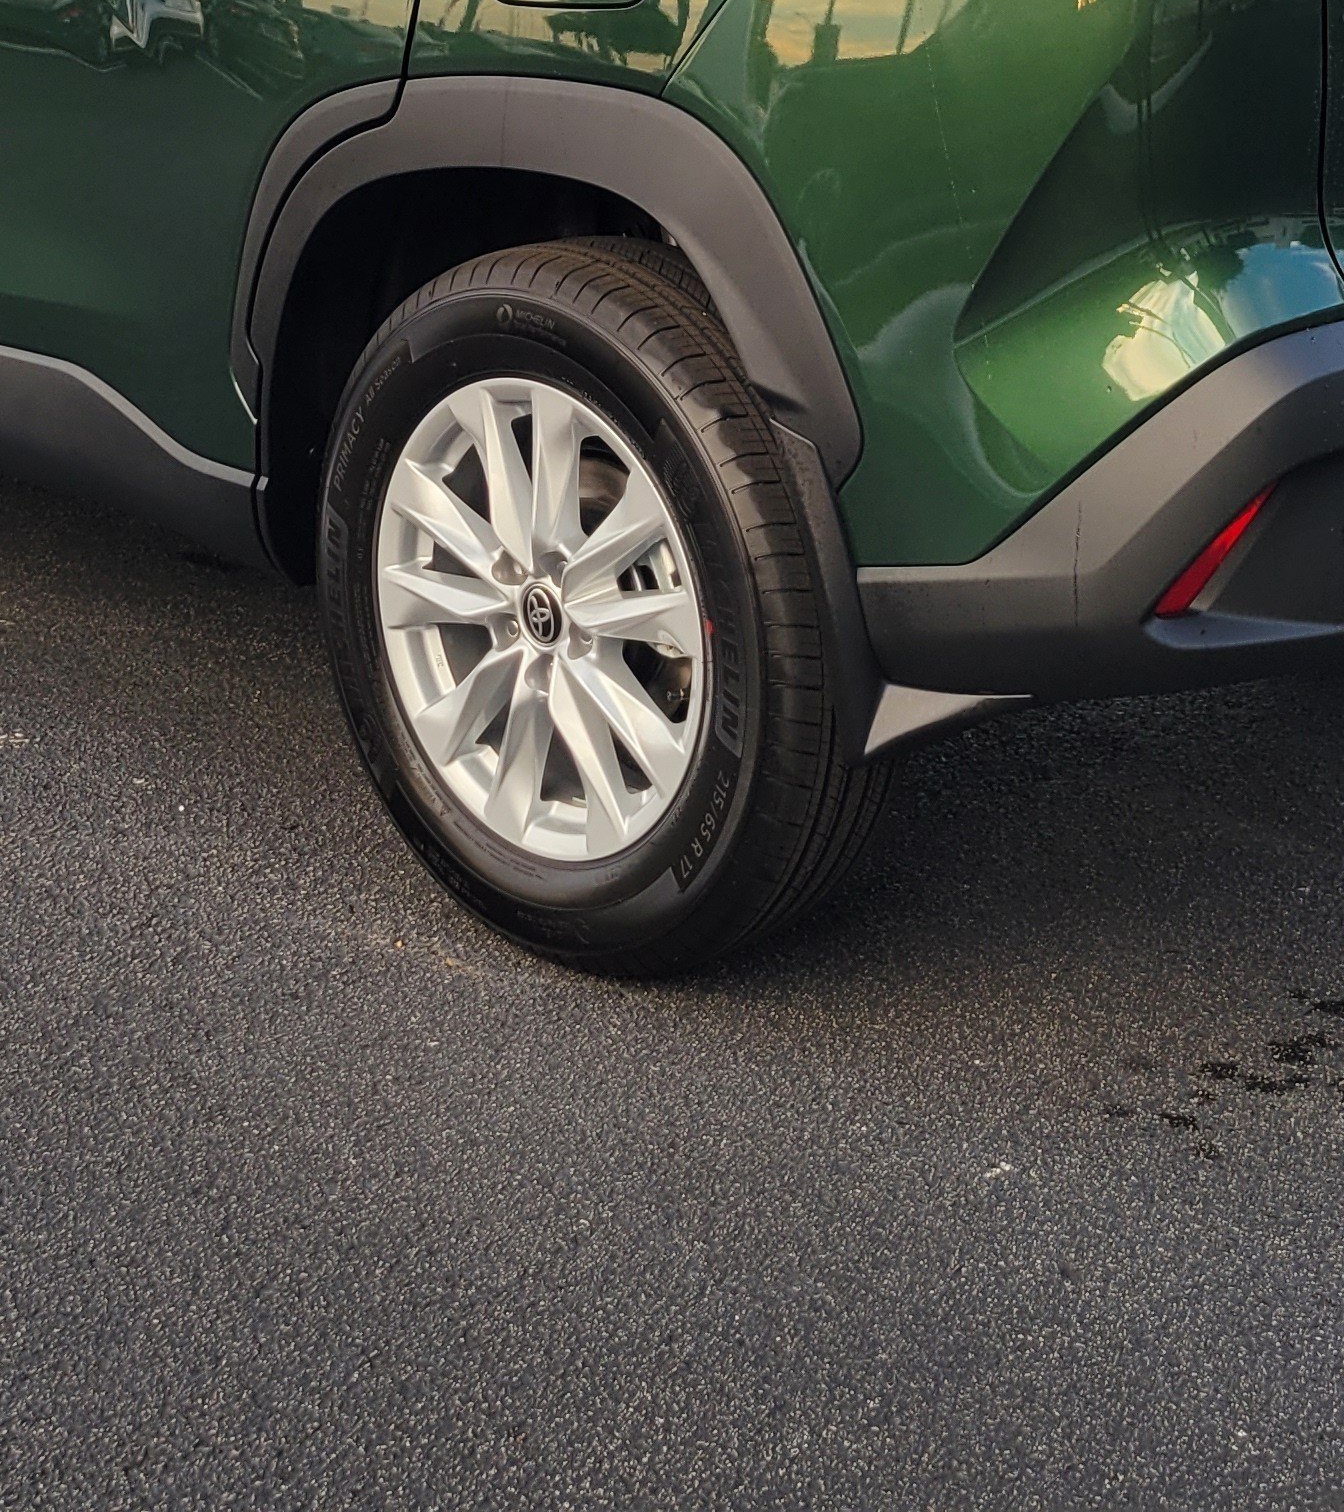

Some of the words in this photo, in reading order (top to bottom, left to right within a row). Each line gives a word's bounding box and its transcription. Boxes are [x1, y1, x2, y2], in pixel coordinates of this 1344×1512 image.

[333, 406, 365, 492] PRIMACY
[700, 769, 730, 842] 215/65
[680, 854, 693, 879] 17
[691, 837, 704, 858] R
